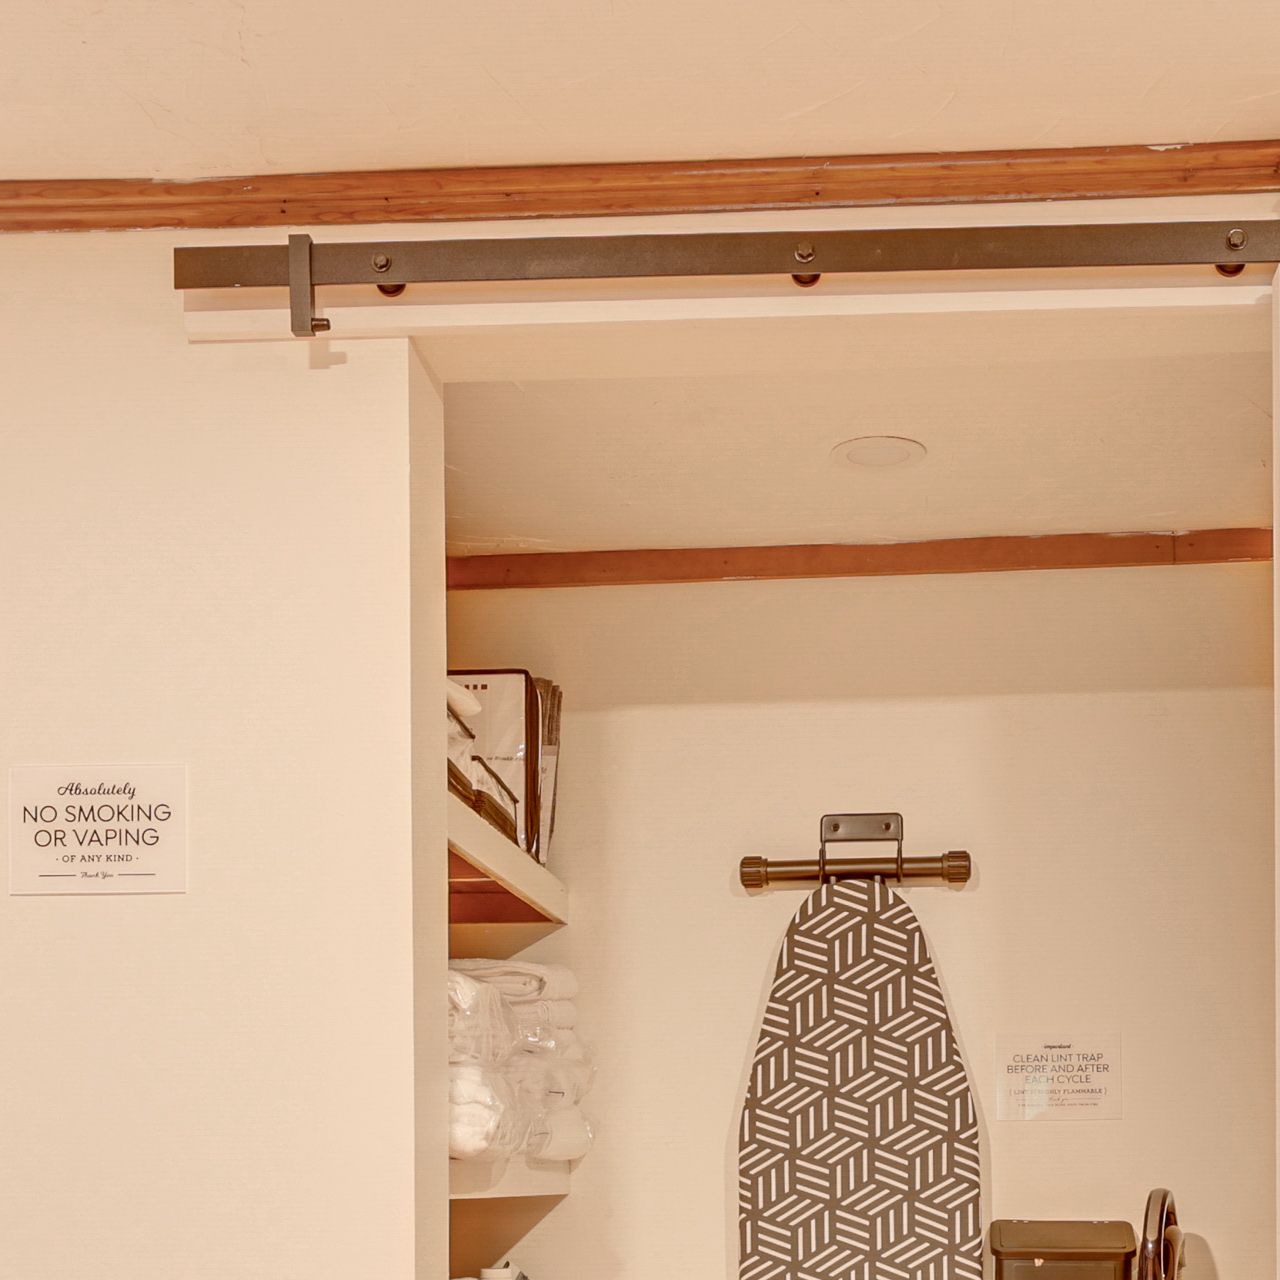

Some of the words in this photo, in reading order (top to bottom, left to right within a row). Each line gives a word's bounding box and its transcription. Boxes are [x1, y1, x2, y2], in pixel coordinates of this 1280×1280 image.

[57, 782, 136, 800] Absolutely
[23, 805, 58, 823] NO
[64, 803, 172, 823] SMOKING
[34, 829, 67, 847] OR
[72, 828, 160, 846] VAPING
[61, 855, 76, 863] OF
[80, 855, 103, 863] ANY
[106, 854, 133, 862] KIND
[1013, 1054, 1049, 1063] CLEAN
[1051, 1054, 1073, 1063] LINT
[1077, 1053, 1104, 1062] TRAP
[1007, 1065, 1048, 1074] BEFORE
[1050, 1064, 1075, 1073] AND
[1077, 1063, 1110, 1073] AFTER
[1025, 1075, 1055, 1084] EACH
[1056, 1074, 1092, 1083] CYCLE
